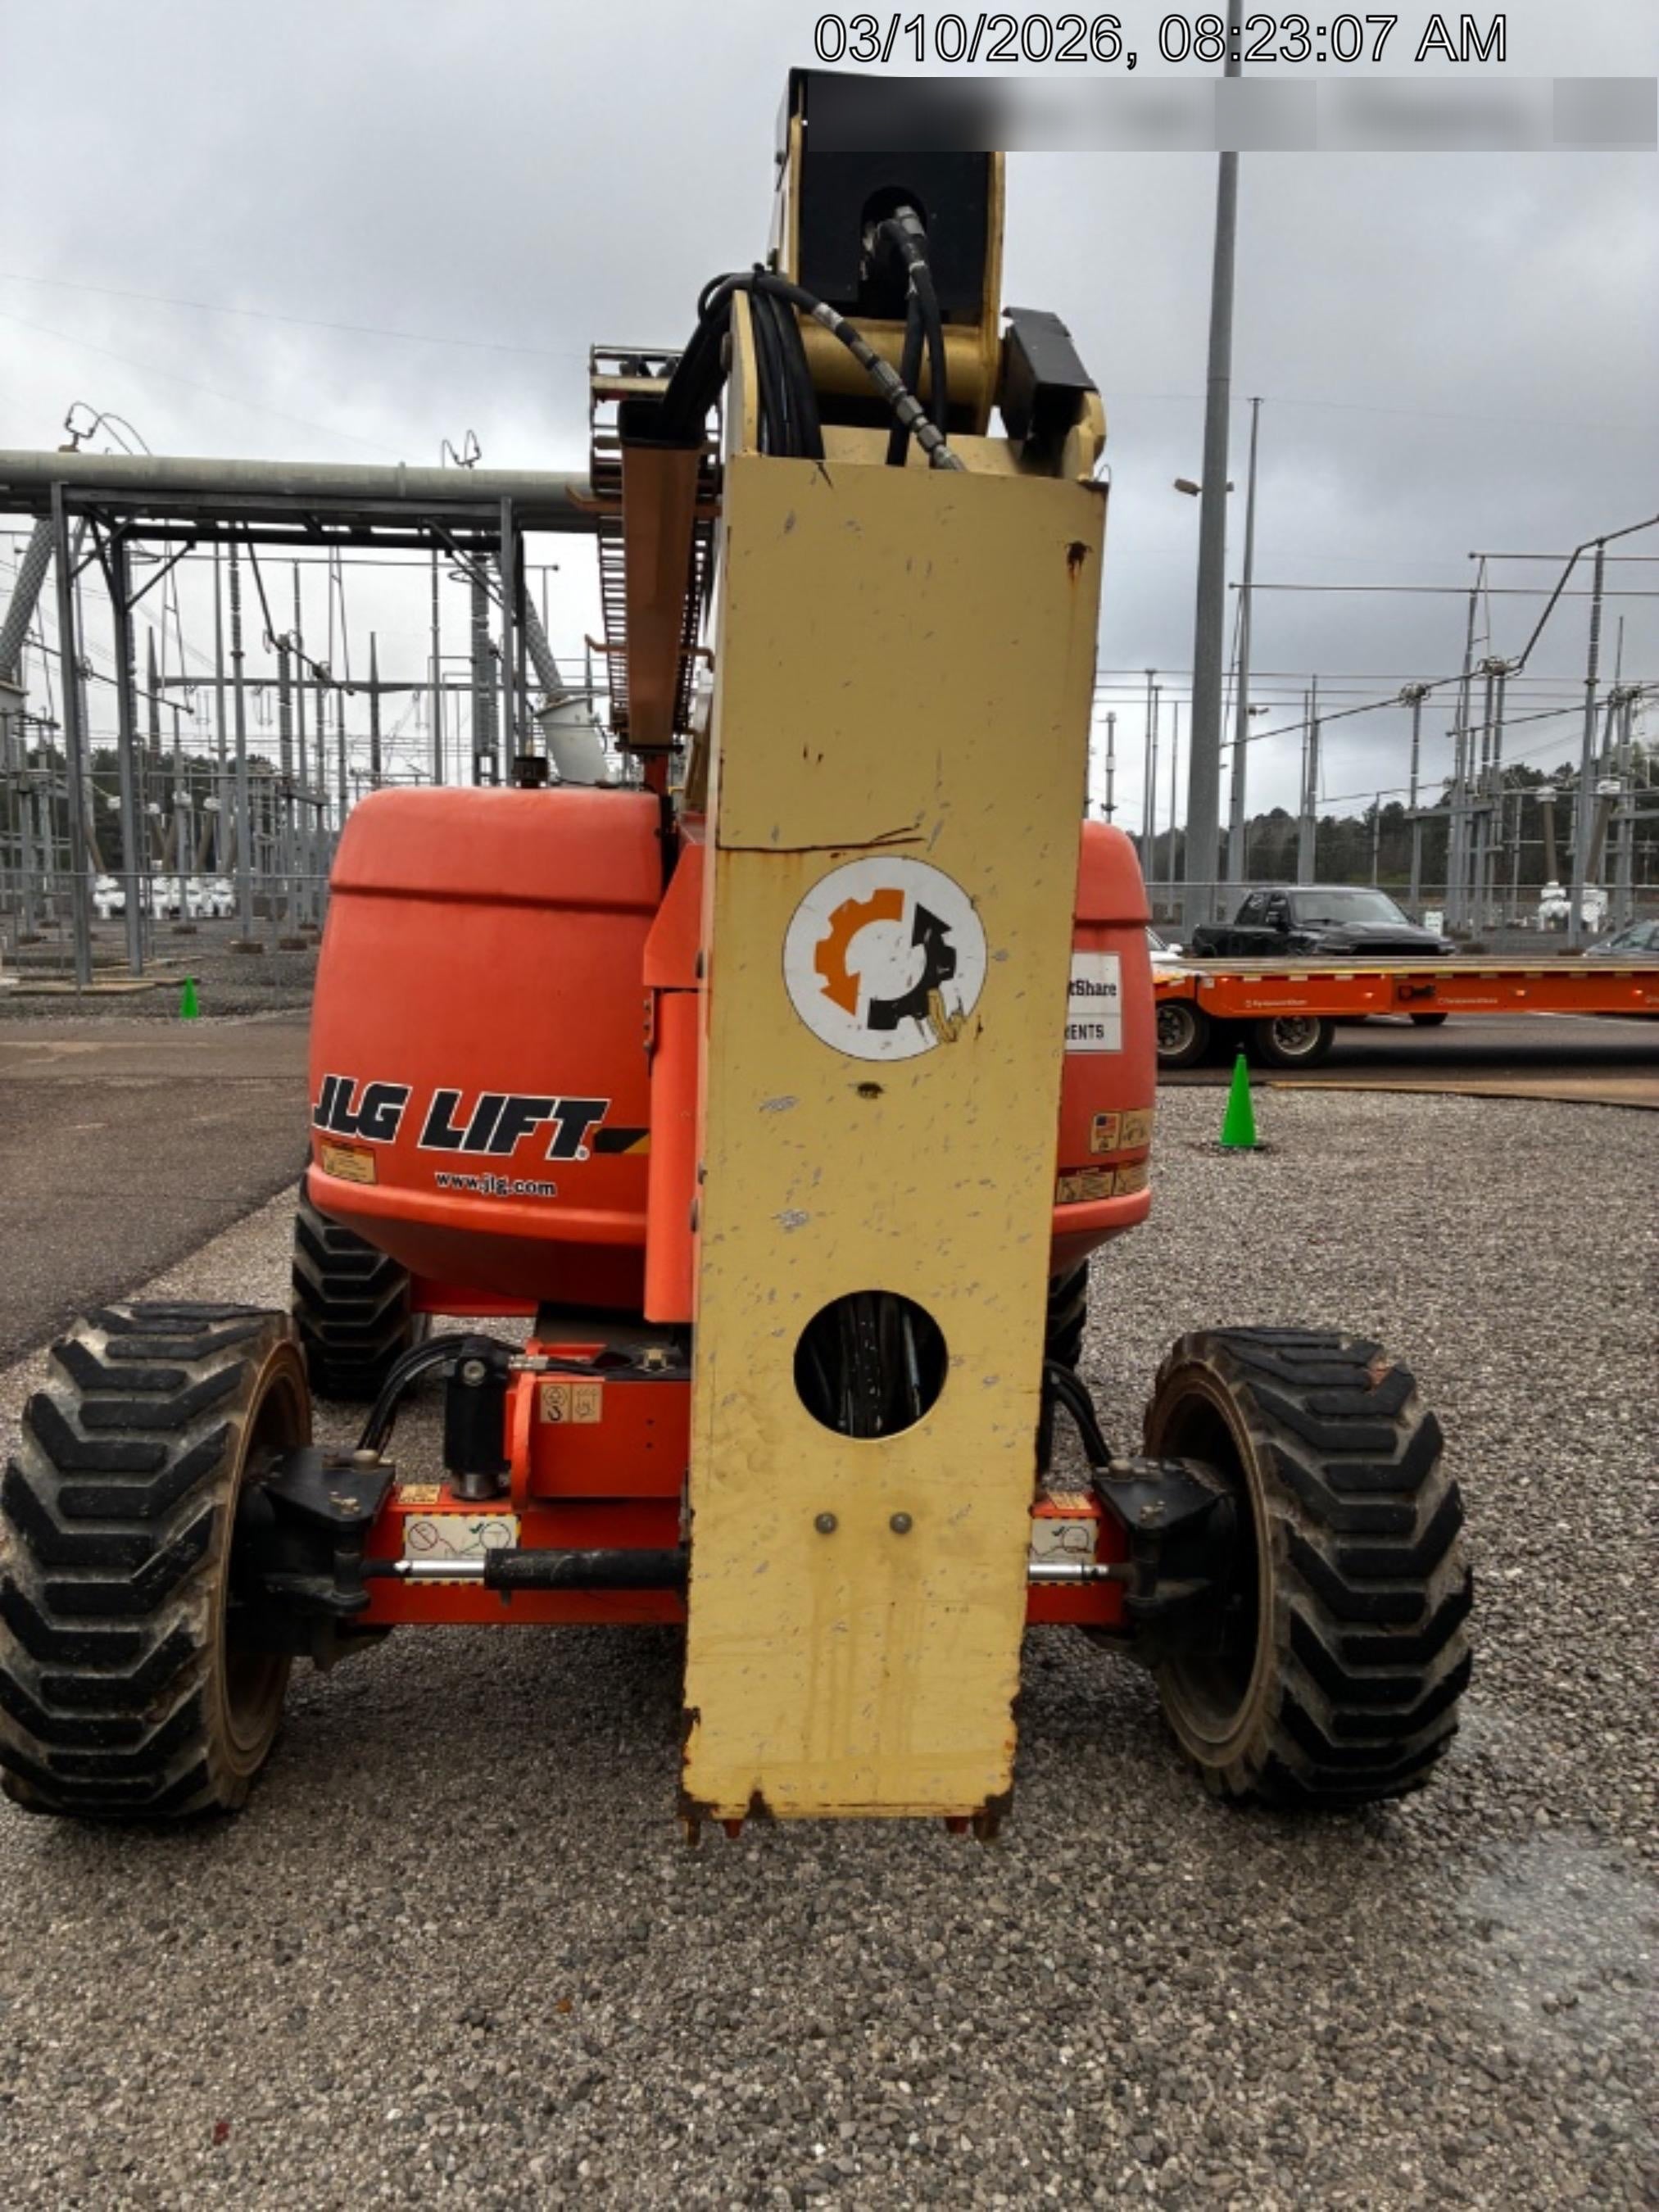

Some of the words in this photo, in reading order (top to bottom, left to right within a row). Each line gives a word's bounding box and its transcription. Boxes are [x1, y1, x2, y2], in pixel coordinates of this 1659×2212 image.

[1068, 979, 1117, 997] tShare
[311, 1073, 412, 1145] JLG
[434, 1171, 556, 1197] www.jlg.com
